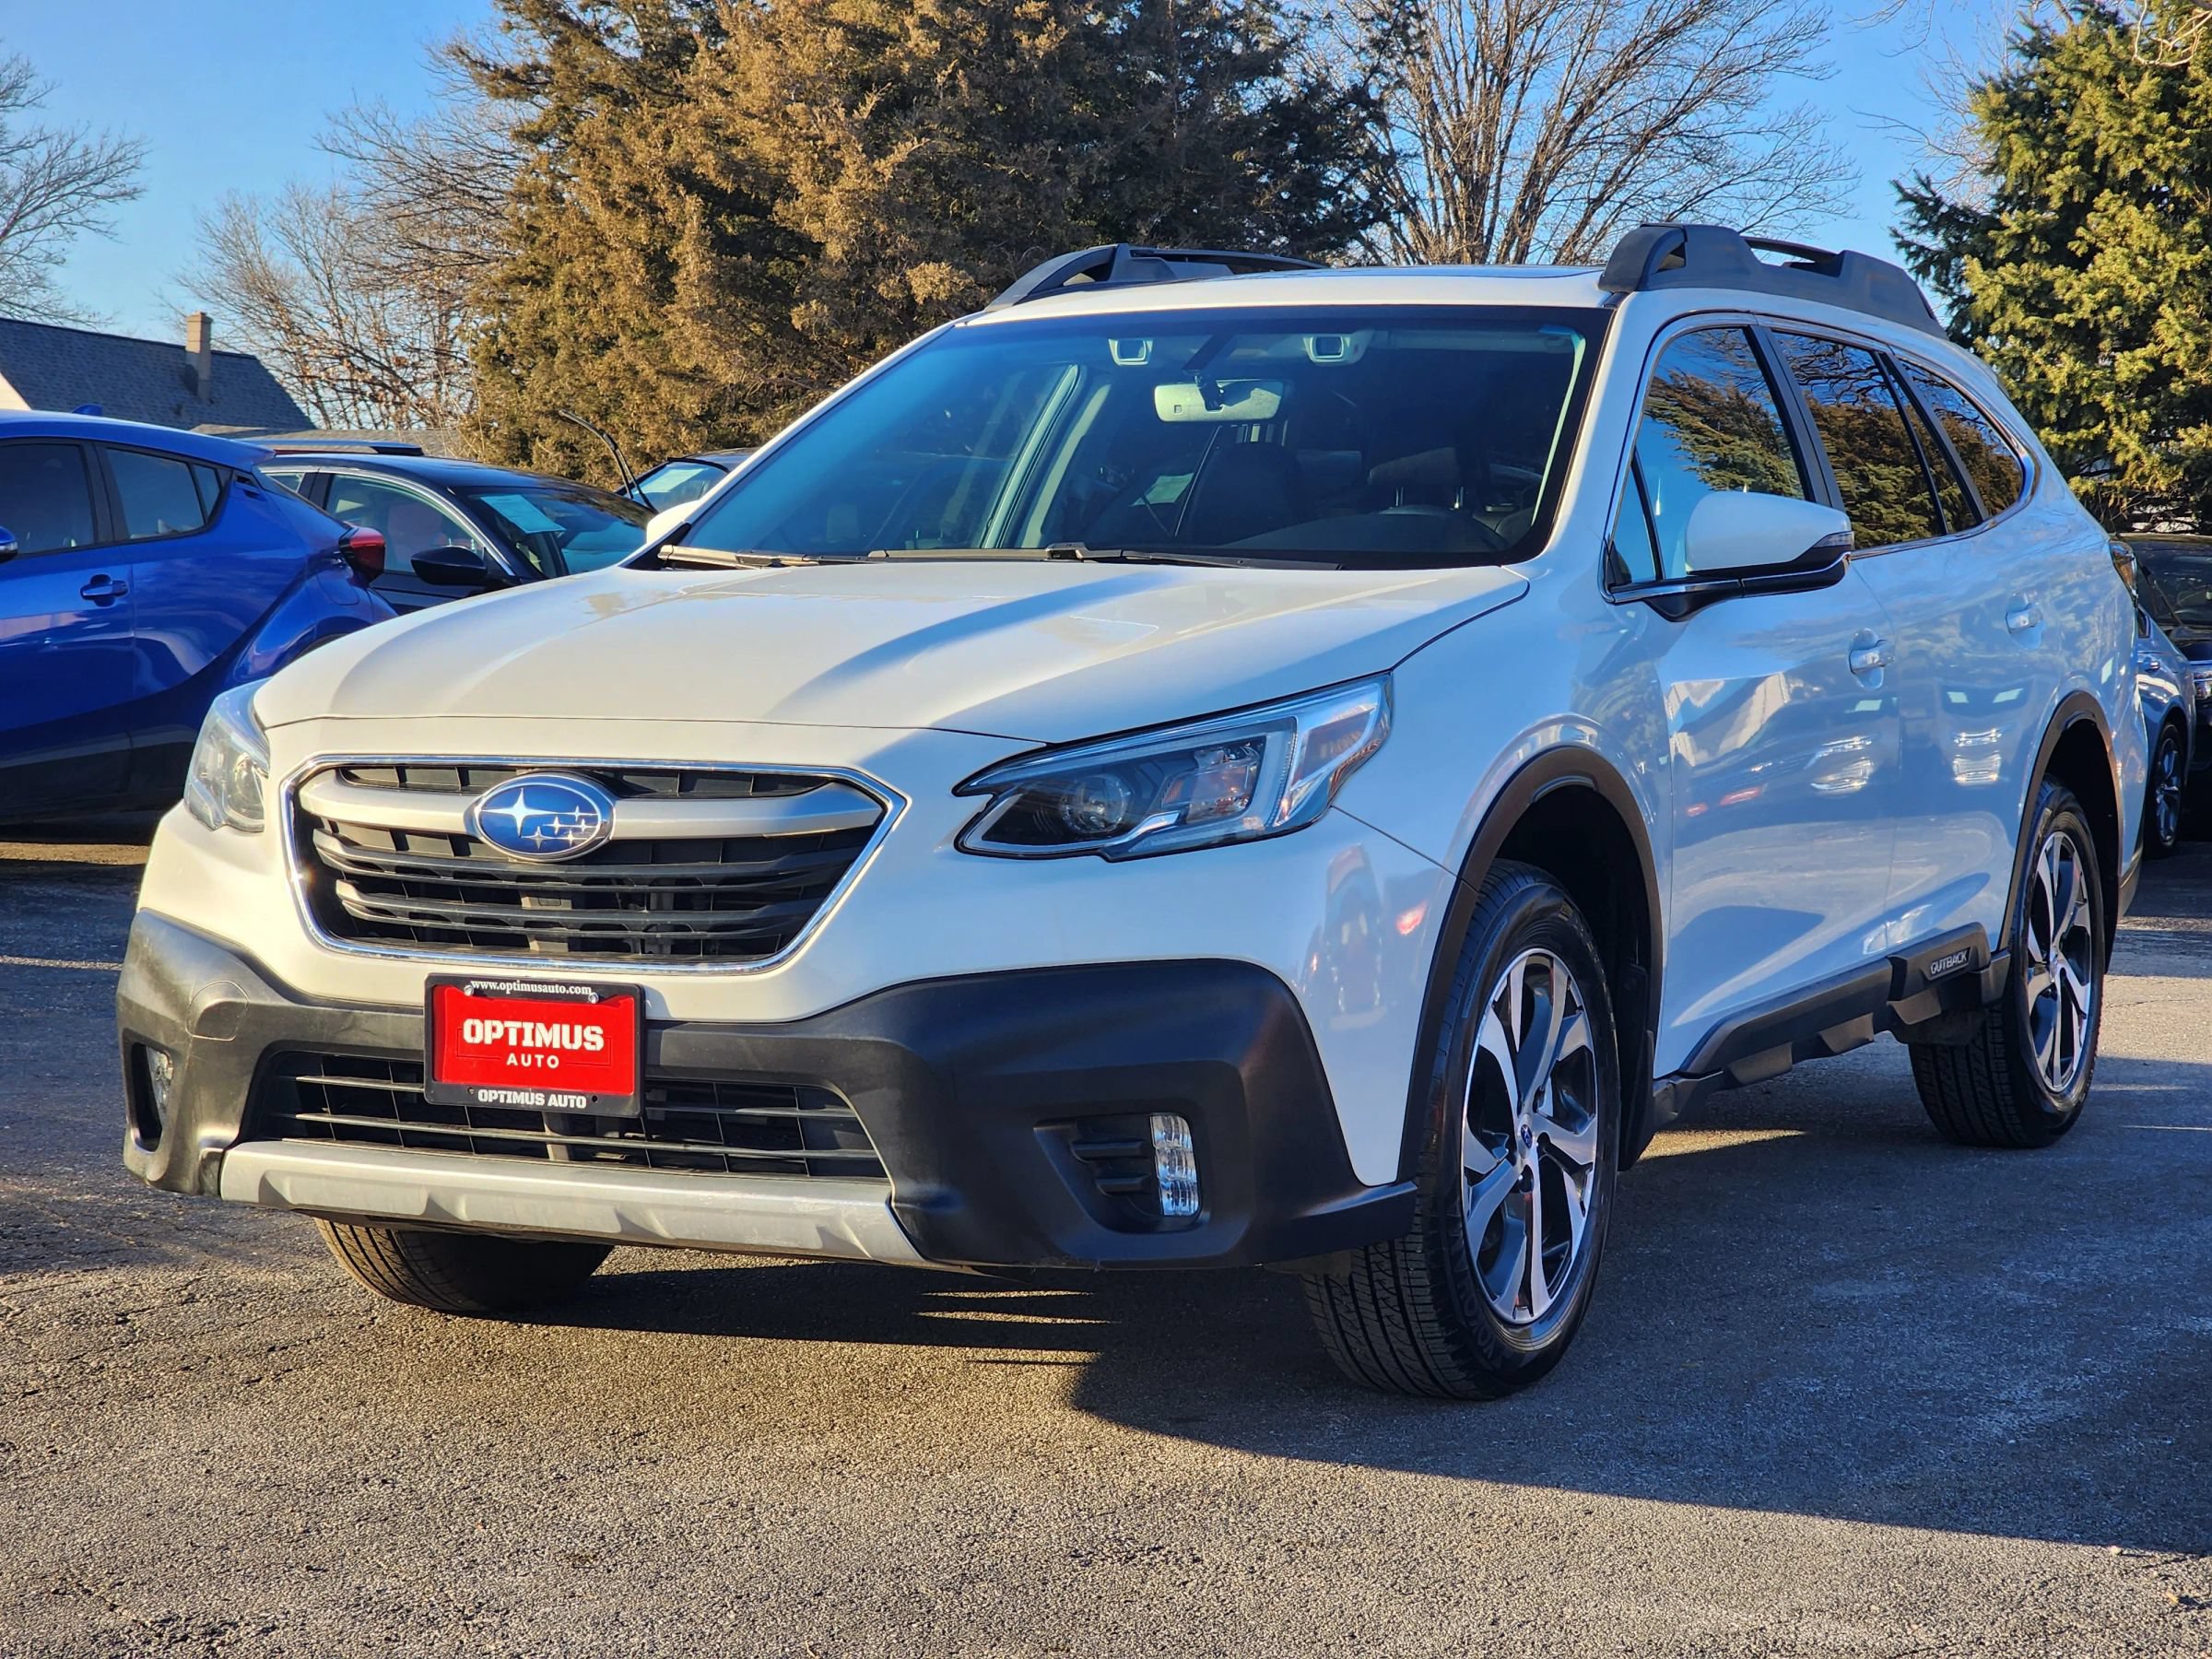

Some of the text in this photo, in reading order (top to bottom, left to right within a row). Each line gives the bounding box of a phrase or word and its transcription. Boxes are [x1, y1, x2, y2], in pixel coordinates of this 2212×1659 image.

[1930, 949, 1967, 974] OUTBACK
[470, 980, 592, 995] www.optimusauto.com
[463, 1018, 605, 1051] OPTIMUS
[506, 1053, 559, 1069] AUTO
[477, 1088, 587, 1109] OPTIMUS AUTO
